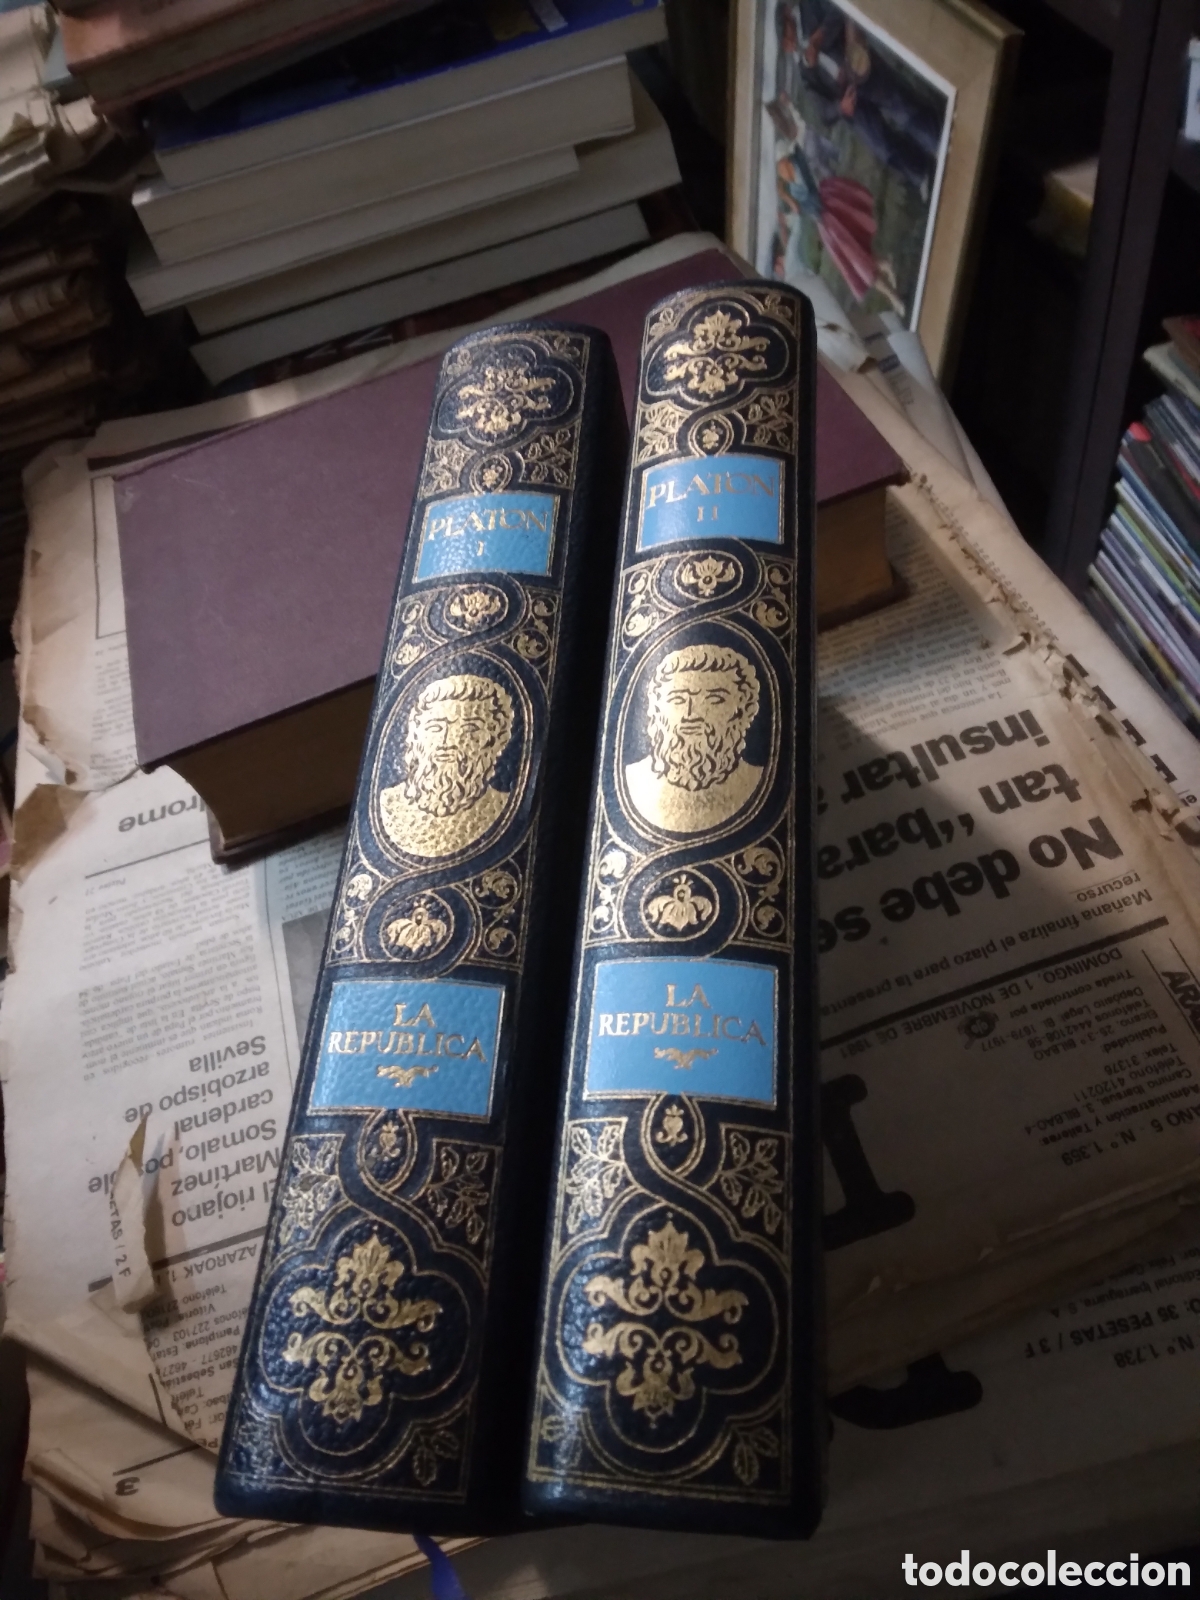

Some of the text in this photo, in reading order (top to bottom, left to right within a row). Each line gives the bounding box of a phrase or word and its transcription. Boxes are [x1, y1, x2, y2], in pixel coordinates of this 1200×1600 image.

[648, 472, 776, 508] PLATON
[427, 508, 547, 541] PLATON
[696, 505, 720, 522] II
[476, 540, 484, 557] I
[829, 709, 1050, 816] insultar
[978, 763, 1082, 815] tan
[1028, 815, 1124, 885] No
[878, 849, 1021, 924] debe
[1074, 872, 1141, 904] recurso
[1079, 888, 1152, 924] Mañana
[1017, 914, 1080, 942] finaliza
[952, 939, 998, 966] plazo
[999, 935, 1016, 951] el
[912, 956, 951, 980] para
[1037, 947, 1122, 984] DOMINGO,
[894, 974, 912, 988] la
[997, 982, 1021, 999] DE
[1009, 969, 1134, 1019] Tirada controlada por
[1024, 978, 1033, 989] 1
[665, 983, 712, 1010] LA
[1092, 985, 1144, 1009] Depósito
[393, 1002, 437, 1028] LA
[900, 992, 995, 1034] NOVIEMBRE
[1094, 998, 1151, 1023] Teléfonos
[598, 1011, 768, 1047] REPUBLICA
[874, 1026, 898, 1044] DE
[1101, 1023, 1167, 1054] Publicidad:
[188, 1035, 266, 1073] Sevilla
[327, 1029, 489, 1063] REPUBLICA
[1033, 1038, 1077, 1061] BILBAO
[1103, 1054, 1140, 1076] 31376
[124, 1061, 270, 1123] arzobispo de
[1073, 1055, 1185, 1103] Teléfono 4120211
[173, 1088, 274, 1139] cardenal
[1105, 1083, 1200, 1123] Administración
[1150, 1118, 1164, 1133] 5
[178, 1118, 277, 1162] Somalo,
[1060, 1140, 1104, 1167] 1.359
[170, 1146, 283, 1201] Martínez
[169, 1186, 255, 1228] riojano
[115, 1254, 127, 1267] 2
[119, 1267, 131, 1278] F
[183, 1243, 257, 1278] AZAROAK
[181, 1284, 226, 1304] Teléfono
[171, 1320, 210, 1341] 227103
[1069, 1310, 1154, 1347] PESETAS
[1023, 1341, 1036, 1359] F
[1038, 1336, 1052, 1354] 3
[1112, 1342, 1160, 1369] 1.738
[115, 1476, 141, 1497] 3
